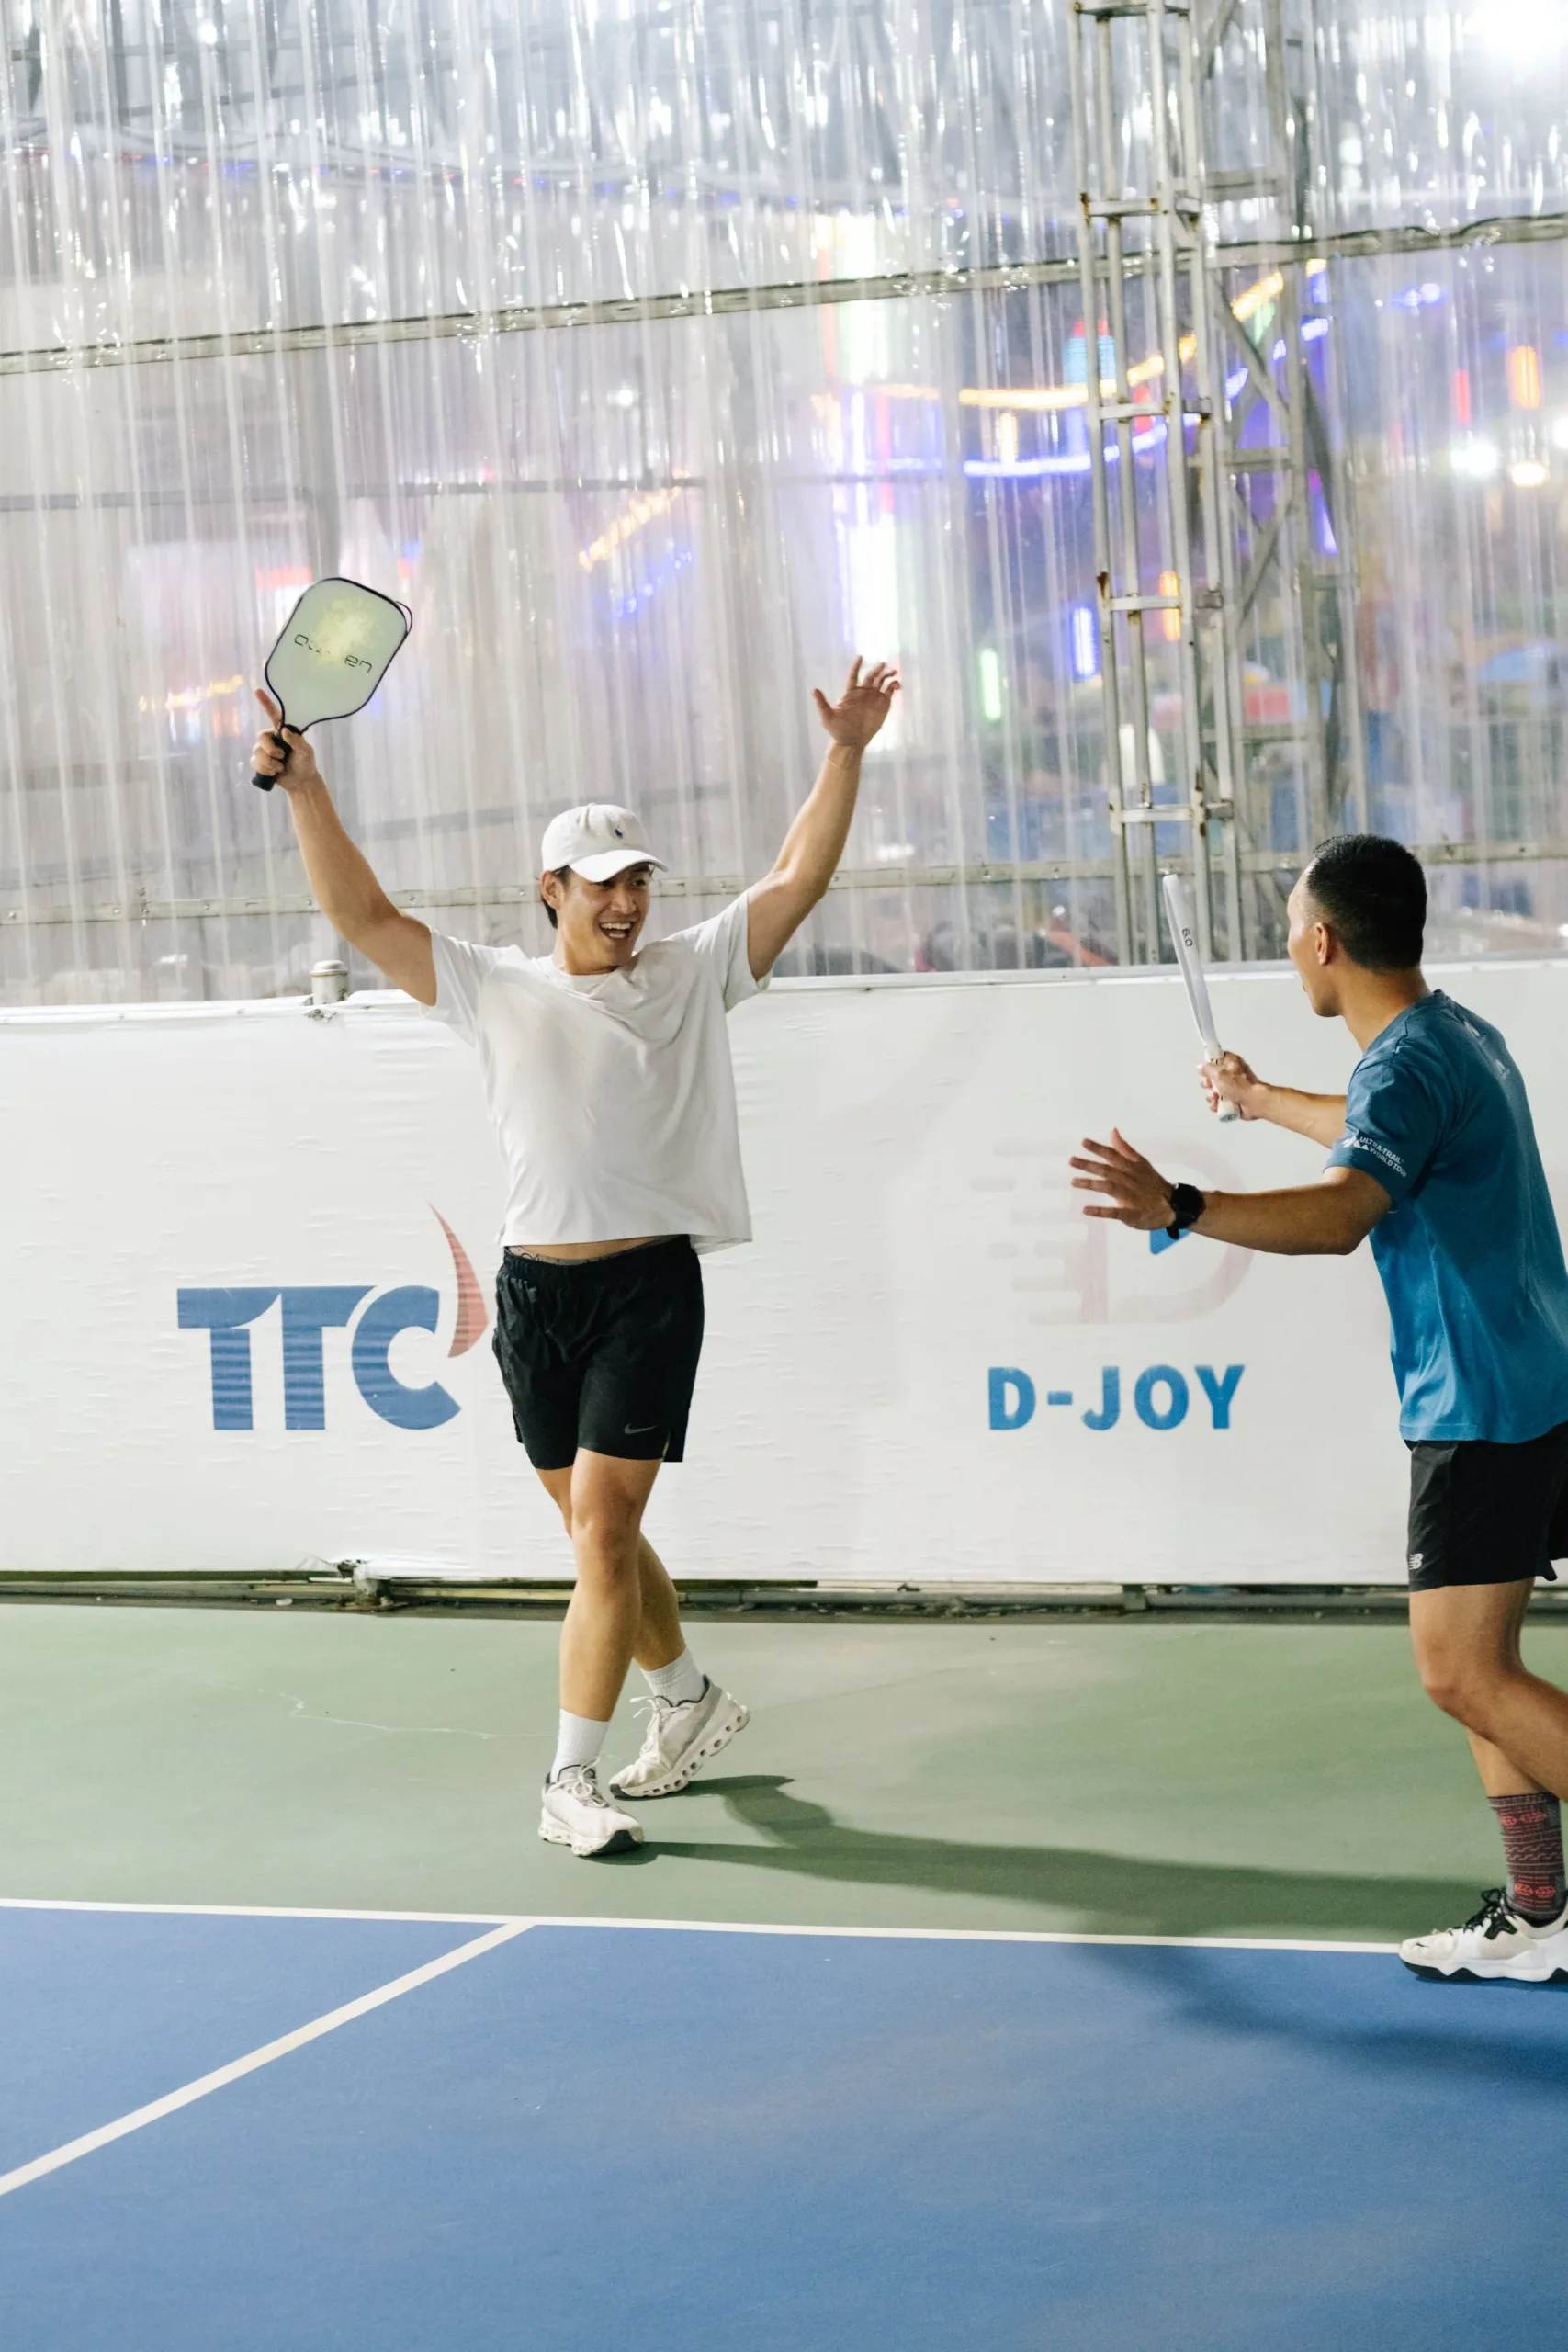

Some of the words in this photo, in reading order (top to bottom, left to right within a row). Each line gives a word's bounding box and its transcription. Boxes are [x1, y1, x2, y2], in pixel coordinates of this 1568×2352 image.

[1359, 1136, 1402, 1164] ULTRA-TRAIL
[1370, 1146, 1393, 1167] WORLD
[1392, 1161, 1408, 1178] TOUR
[176, 1284, 462, 1430] TTC
[987, 1364, 1246, 1431] D-JOY
